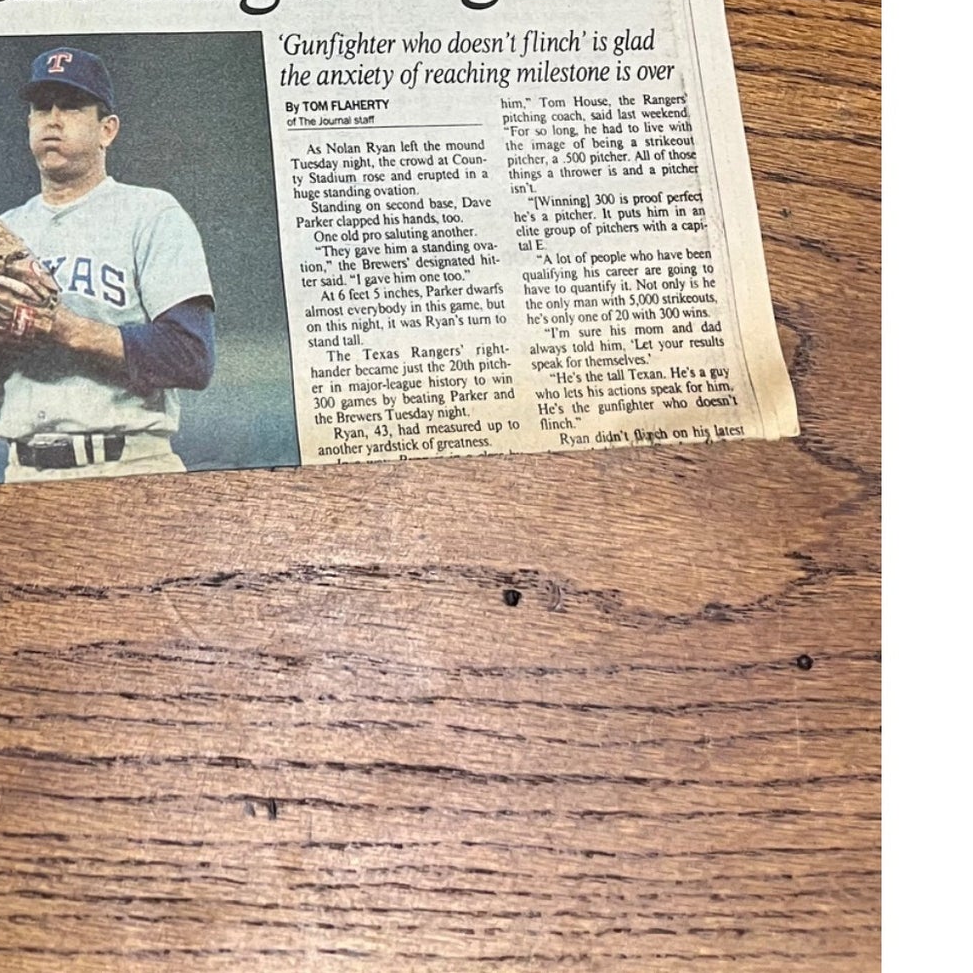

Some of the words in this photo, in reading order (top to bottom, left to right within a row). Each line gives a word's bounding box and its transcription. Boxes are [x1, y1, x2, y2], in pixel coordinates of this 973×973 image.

[278, 31, 396, 62] 'Gunfighter
[402, 31, 442, 54] who
[448, 30, 516, 54] doesn't
[520, 28, 586, 58] flinch'
[592, 30, 607, 52] is
[612, 28, 655, 57] glad
[47, 52, 73, 74] T
[279, 63, 310, 86] the
[317, 63, 394, 91] anxiety
[400, 61, 424, 89] of
[425, 61, 511, 89] reaching
[516, 58, 611, 83] milestone
[616, 60, 631, 82] is
[637, 64, 676, 82] over
[285, 101, 299, 114] By
[302, 100, 329, 111] TOM
[331, 98, 390, 111] FLAHERTY
[286, 116, 296, 127] of
[297, 115, 316, 126] The
[318, 115, 352, 126] Journal
[354, 114, 375, 125] staff
[291, 158, 338, 174] Tuesday
[343, 157, 374, 171] night,
[378, 156, 395, 167] the
[399, 155, 433, 167] crowd
[438, 156, 448, 165] at
[452, 152, 487, 164] Coun-
[42, 256, 126, 308] XAS
[525, 298, 542, 310] the
[546, 297, 569, 312] only
[573, 298, 597, 308] man
[601, 295, 625, 307] with
[629, 293, 659, 307] 5,000
[662, 291, 717, 306] strikeouts,
[308, 335, 339, 347] stand
[342, 334, 363, 346] tall.
